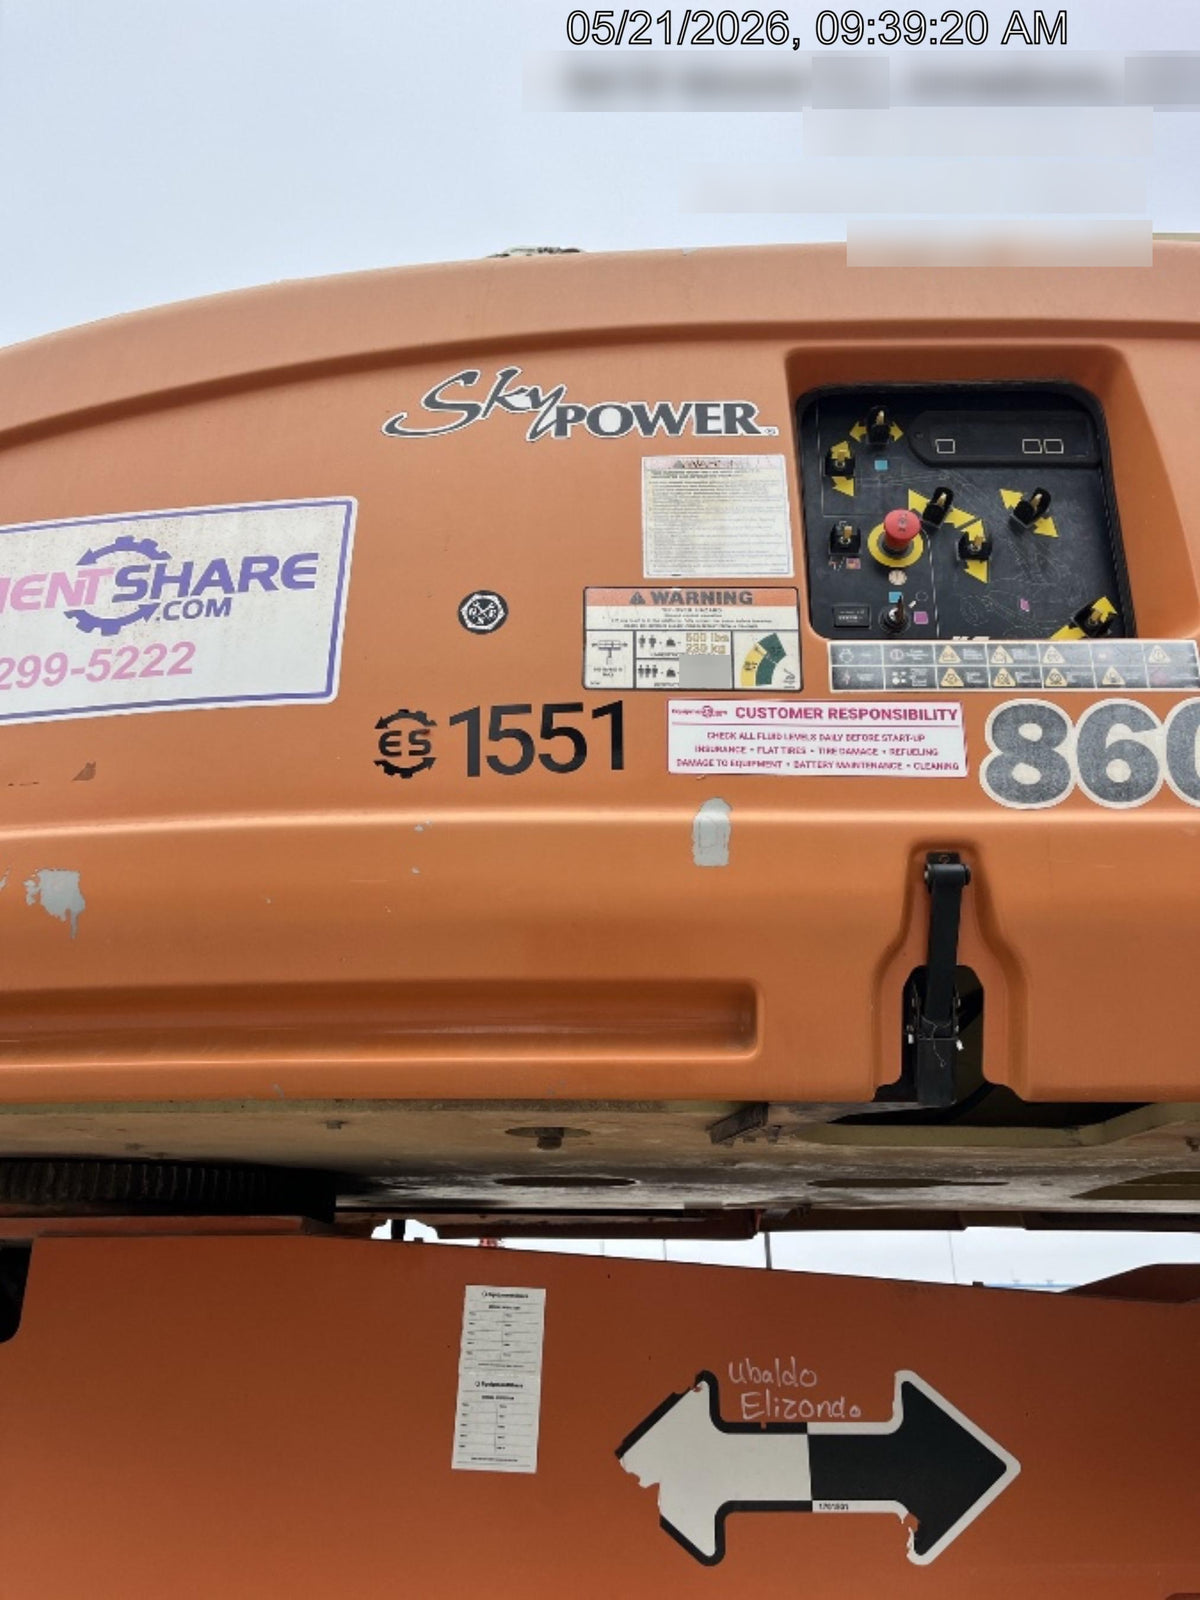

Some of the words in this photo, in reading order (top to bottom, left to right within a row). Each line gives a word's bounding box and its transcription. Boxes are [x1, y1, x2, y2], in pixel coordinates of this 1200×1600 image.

[0, 552, 319, 613] ENTSHARE
[650, 591, 753, 606] WARNING
[735, 707, 823, 719] CUSTOMER
[828, 707, 957, 721] RESPONSIBILITY
[378, 729, 431, 756] ES
[449, 700, 624, 777] 1551
[707, 732, 736, 740] CHECK
[739, 732, 756, 740] ALL
[757, 733, 782, 741] FLUID
[819, 733, 843, 742] DAILY
[846, 734, 880, 742] BEFORE
[882, 734, 925, 742] START-UP
[757, 746, 779, 754] FLAT
[782, 746, 806, 754] TIRES
[890, 748, 939, 757] REFUELING
[677, 758, 714, 767] DAMAGE
[717, 759, 728, 767] TO
[731, 759, 782, 769] EQUIPMENT
[794, 760, 833, 769] BATTERY
[836, 761, 903, 770] MAINTENANCE
[914, 762, 959, 771] CLEANING
